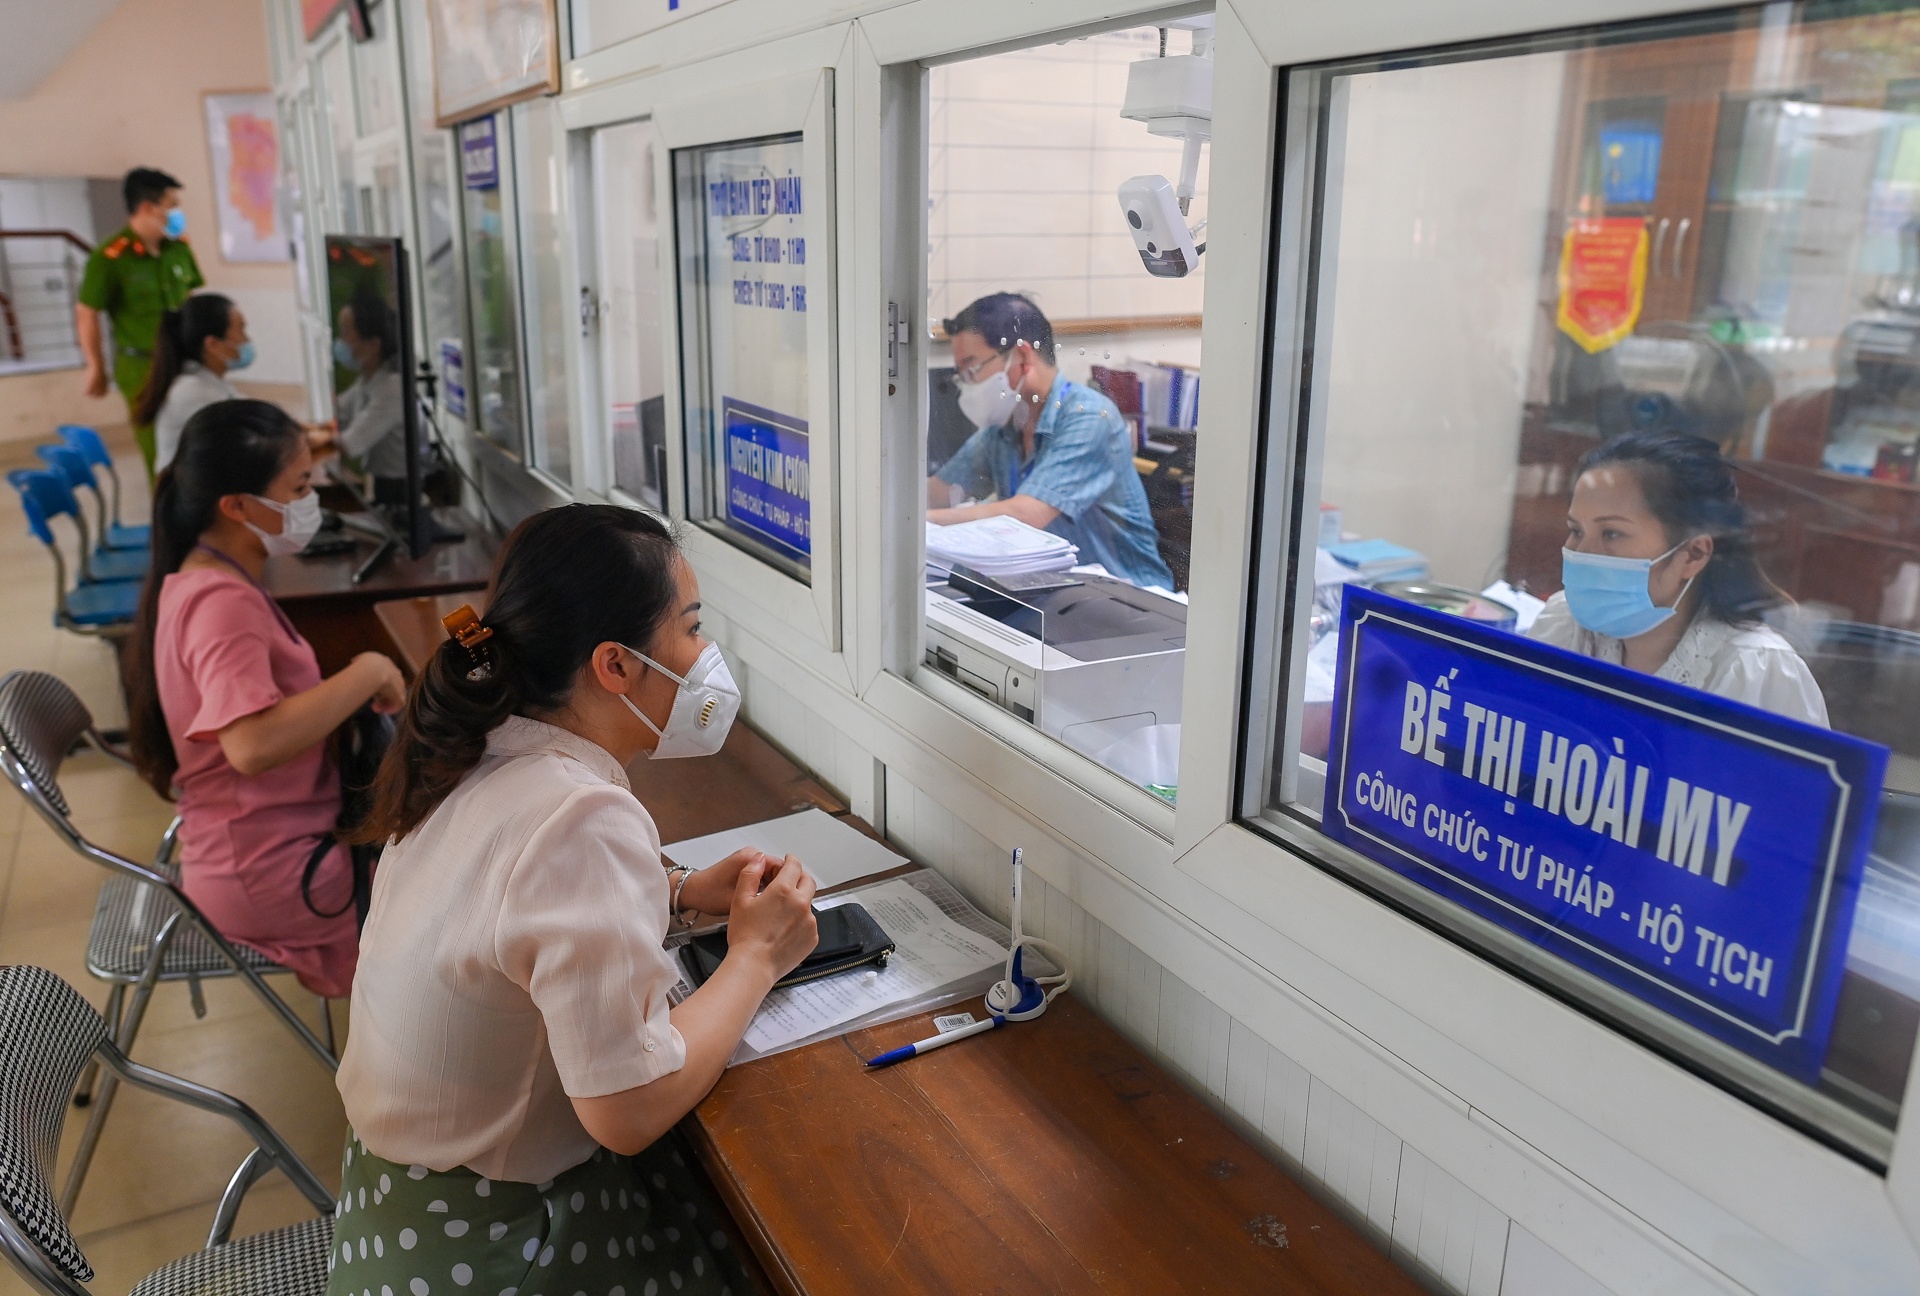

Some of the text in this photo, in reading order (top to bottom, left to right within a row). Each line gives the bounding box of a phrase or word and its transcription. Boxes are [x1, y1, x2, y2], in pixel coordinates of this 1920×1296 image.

[752, 167, 771, 215] TIẾP
[775, 168, 802, 224] NHẬN
[765, 447, 784, 490] KIM
[773, 504, 790, 529] PHÁP
[794, 513, 803, 541] HỘ
[1400, 668, 1751, 887] BẾ THỊ HOÀI MY
[1355, 771, 1773, 998] CÔNG CHỨC TƯ PHÁP - HỘ TỊCH
